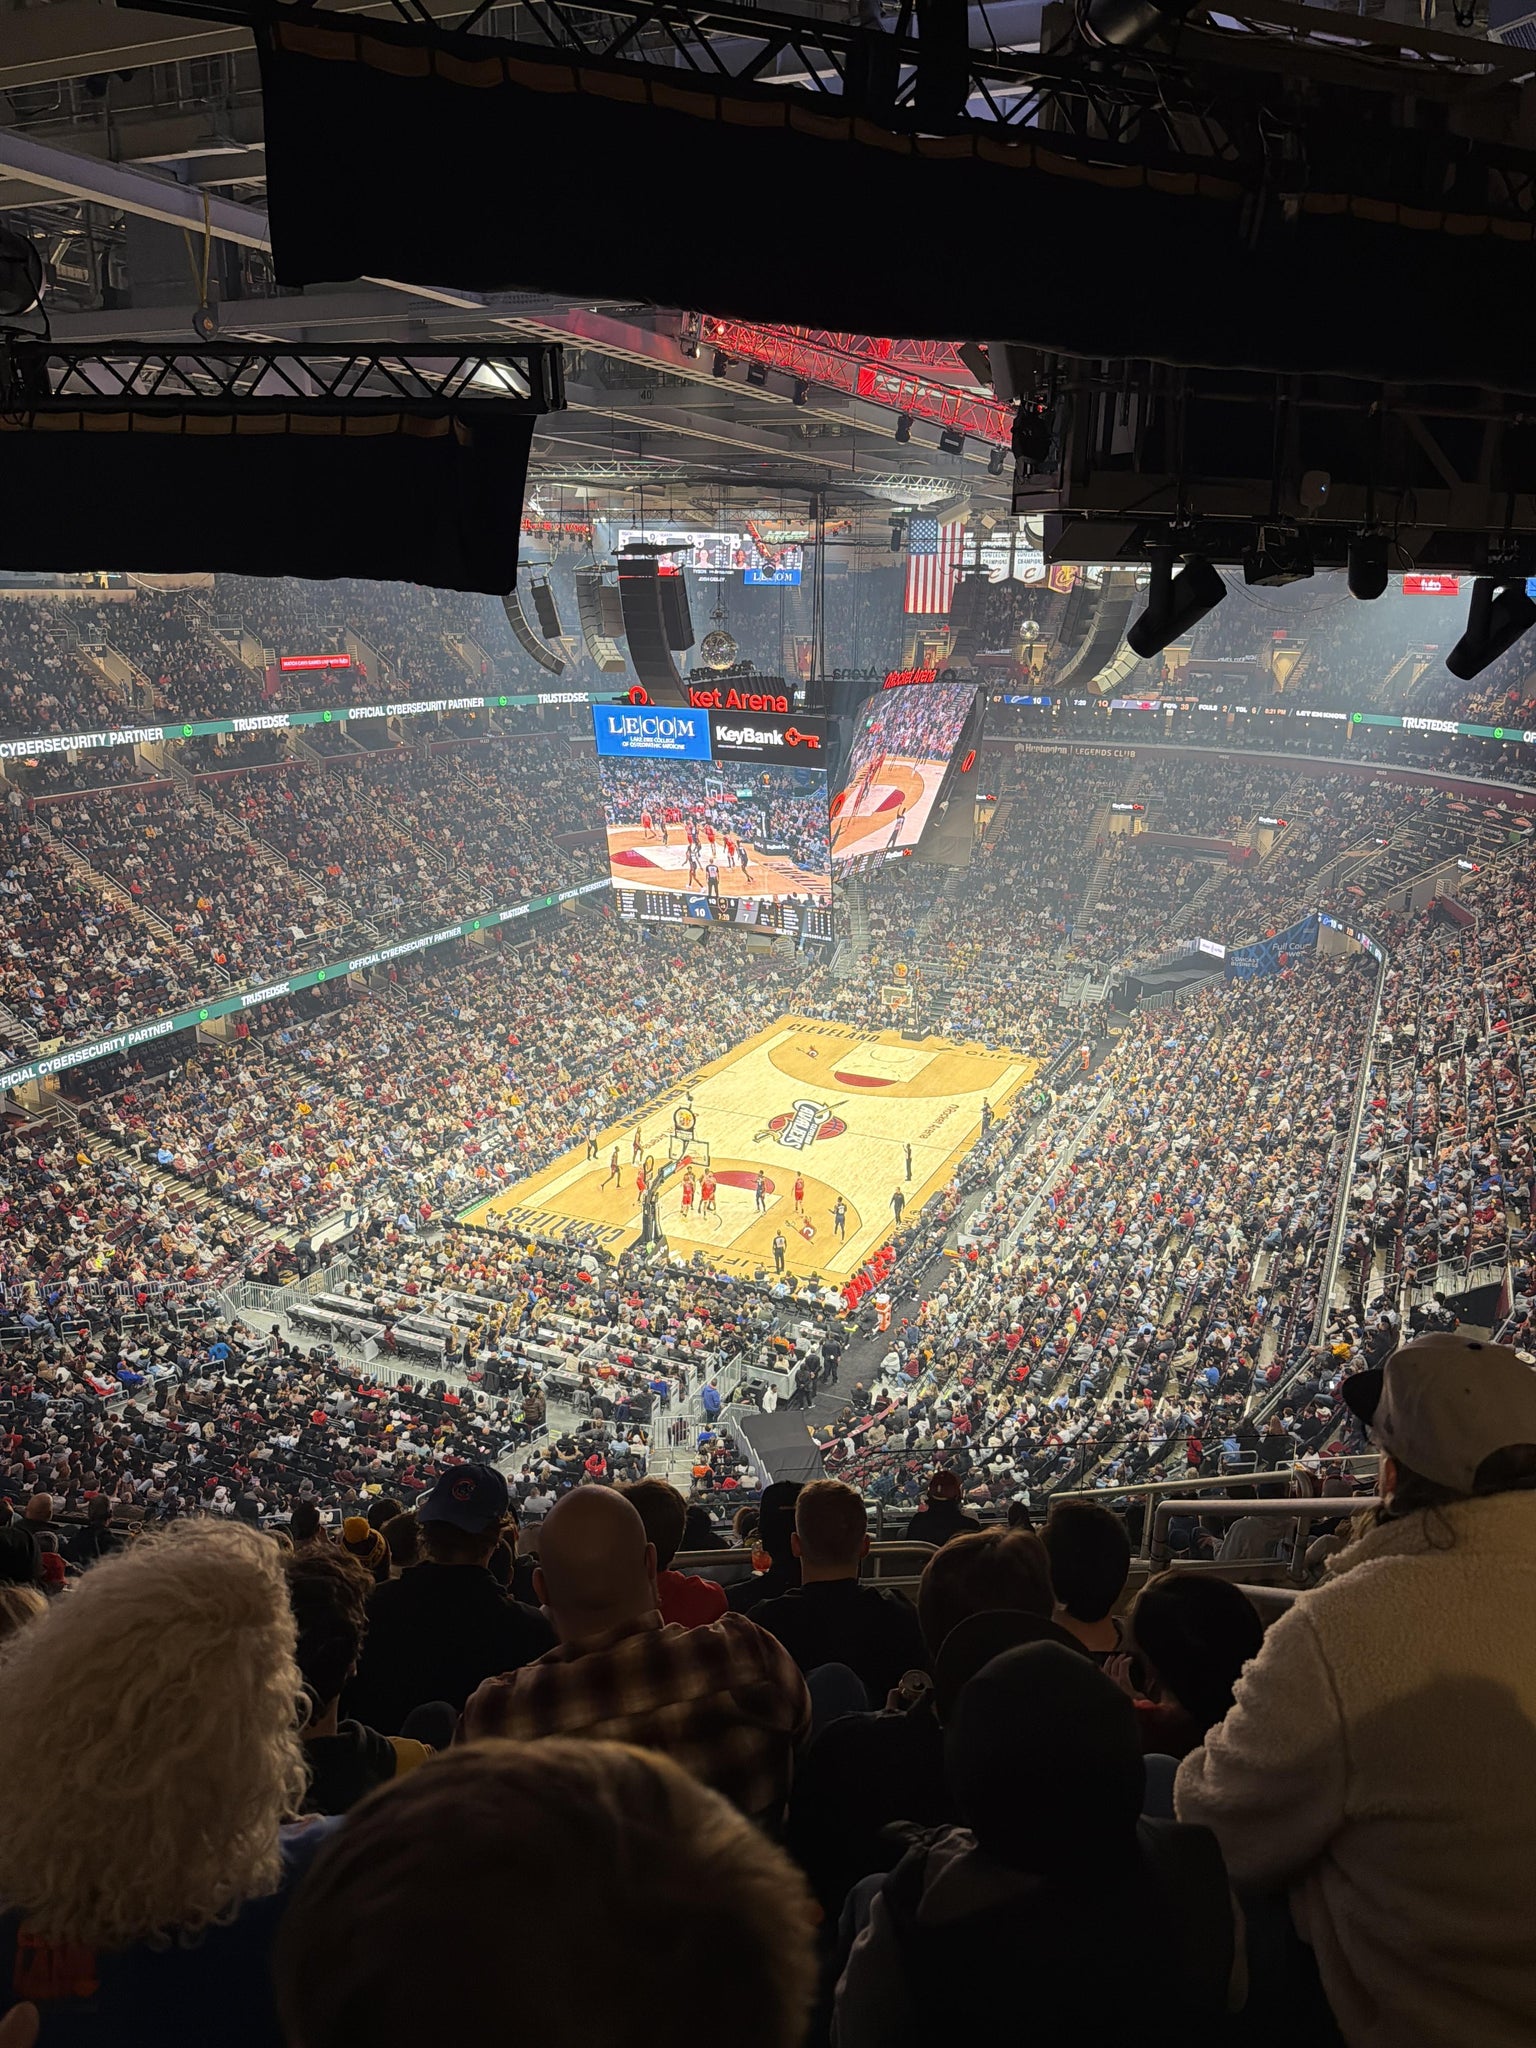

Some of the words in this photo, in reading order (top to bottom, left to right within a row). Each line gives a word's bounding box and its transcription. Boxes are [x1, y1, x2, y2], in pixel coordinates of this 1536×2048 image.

[753, 572, 792, 582] LOM
[537, 692, 589, 704] TRUSTEDSEC
[725, 688, 788, 713] Arena
[1032, 697, 1042, 705] 10
[349, 706, 385, 720] OFFICIAL
[386, 700, 447, 717] CYBERSECURITY
[448, 697, 484, 711] PARTNER
[233, 714, 290, 732] TRUSTEDSEC
[1401, 716, 1459, 734] TRUSTEDSEC
[0, 733, 107, 758] CYBERSECURITY
[109, 727, 163, 746] PARTNER
[716, 725, 784, 747] KeyBank
[1523, 730, 1536, 744] OF
[1075, 747, 1112, 758] LEGENDS
[1114, 750, 1136, 758] CLUB
[558, 888, 579, 901] OFFICIAL
[579, 877, 612, 896] CYBERSECURIT
[499, 904, 530, 921] TRUSTEDSEC
[694, 908, 706, 917] 10
[349, 952, 381, 971] OFFICIAL
[381, 936, 434, 960] CYBERSECURITY
[434, 926, 462, 944] PARTNER
[1230, 956, 1260, 964] COMCAST
[1230, 961, 1259, 969] BUSINESS
[241, 982, 290, 1007] TRUSTEDSEC
[787, 1023, 881, 1043] CLEVELAND
[0, 1067, 37, 1089] FICIAL
[38, 1035, 126, 1073] CYBERSECURITY
[128, 1020, 173, 1045] PARTNER
[964, 1050, 1033, 1064] CLIFFS
